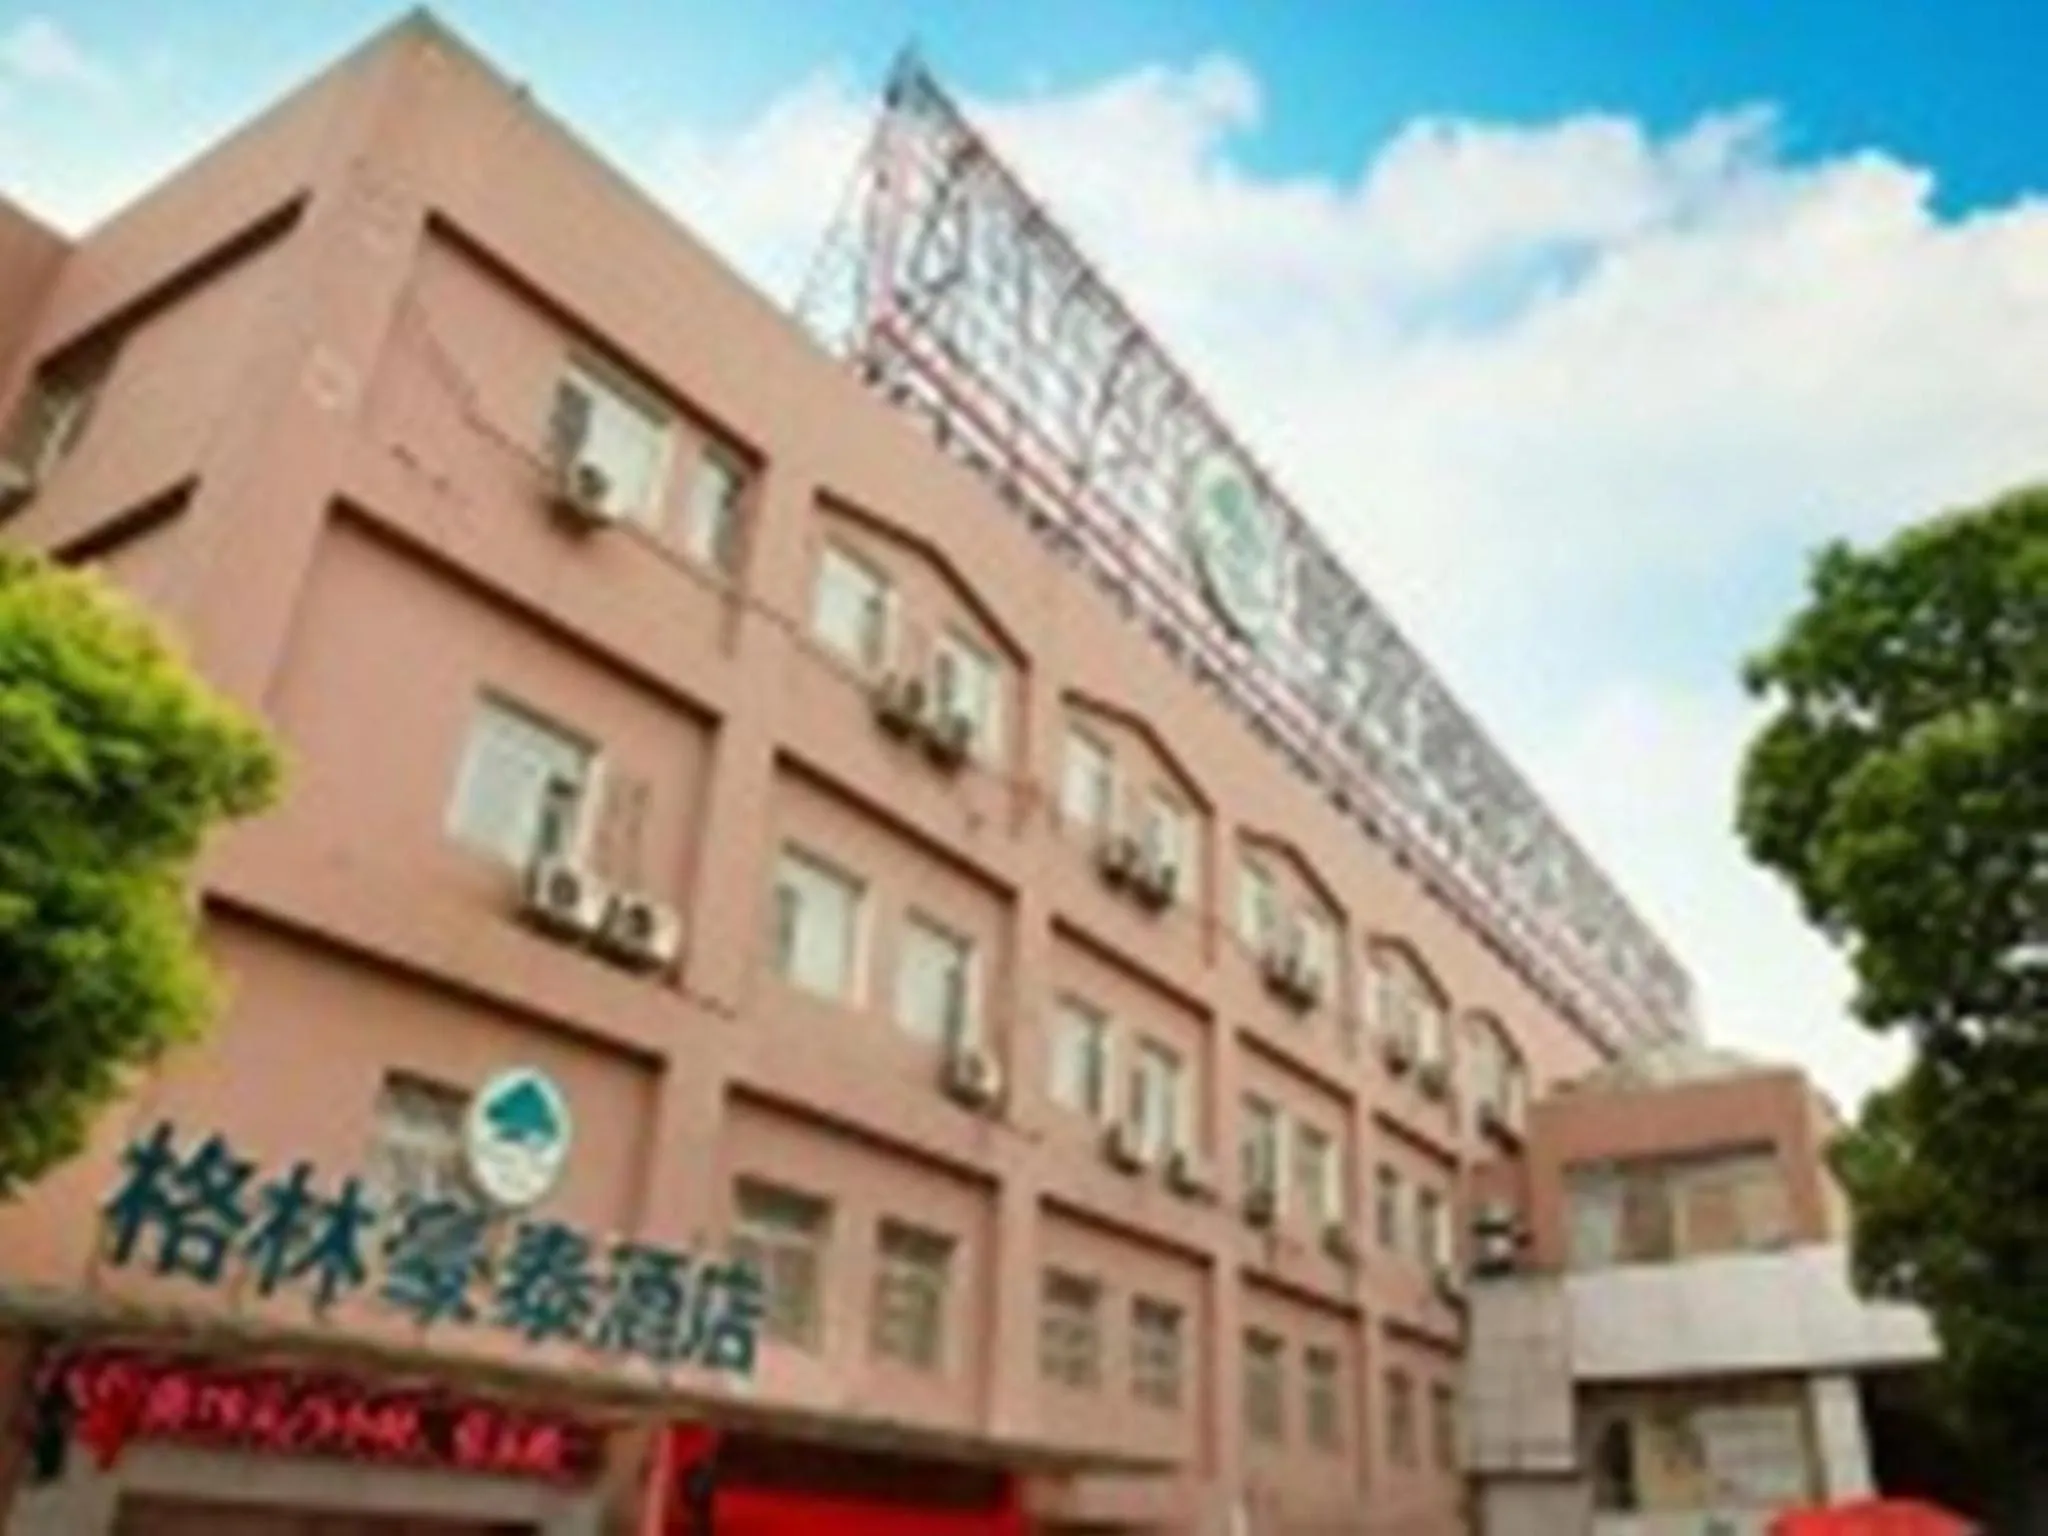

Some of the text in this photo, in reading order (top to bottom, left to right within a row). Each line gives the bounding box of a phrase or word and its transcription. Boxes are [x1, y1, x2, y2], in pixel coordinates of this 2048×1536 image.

[105, 1121, 764, 1374] 格林豪泰酒店
